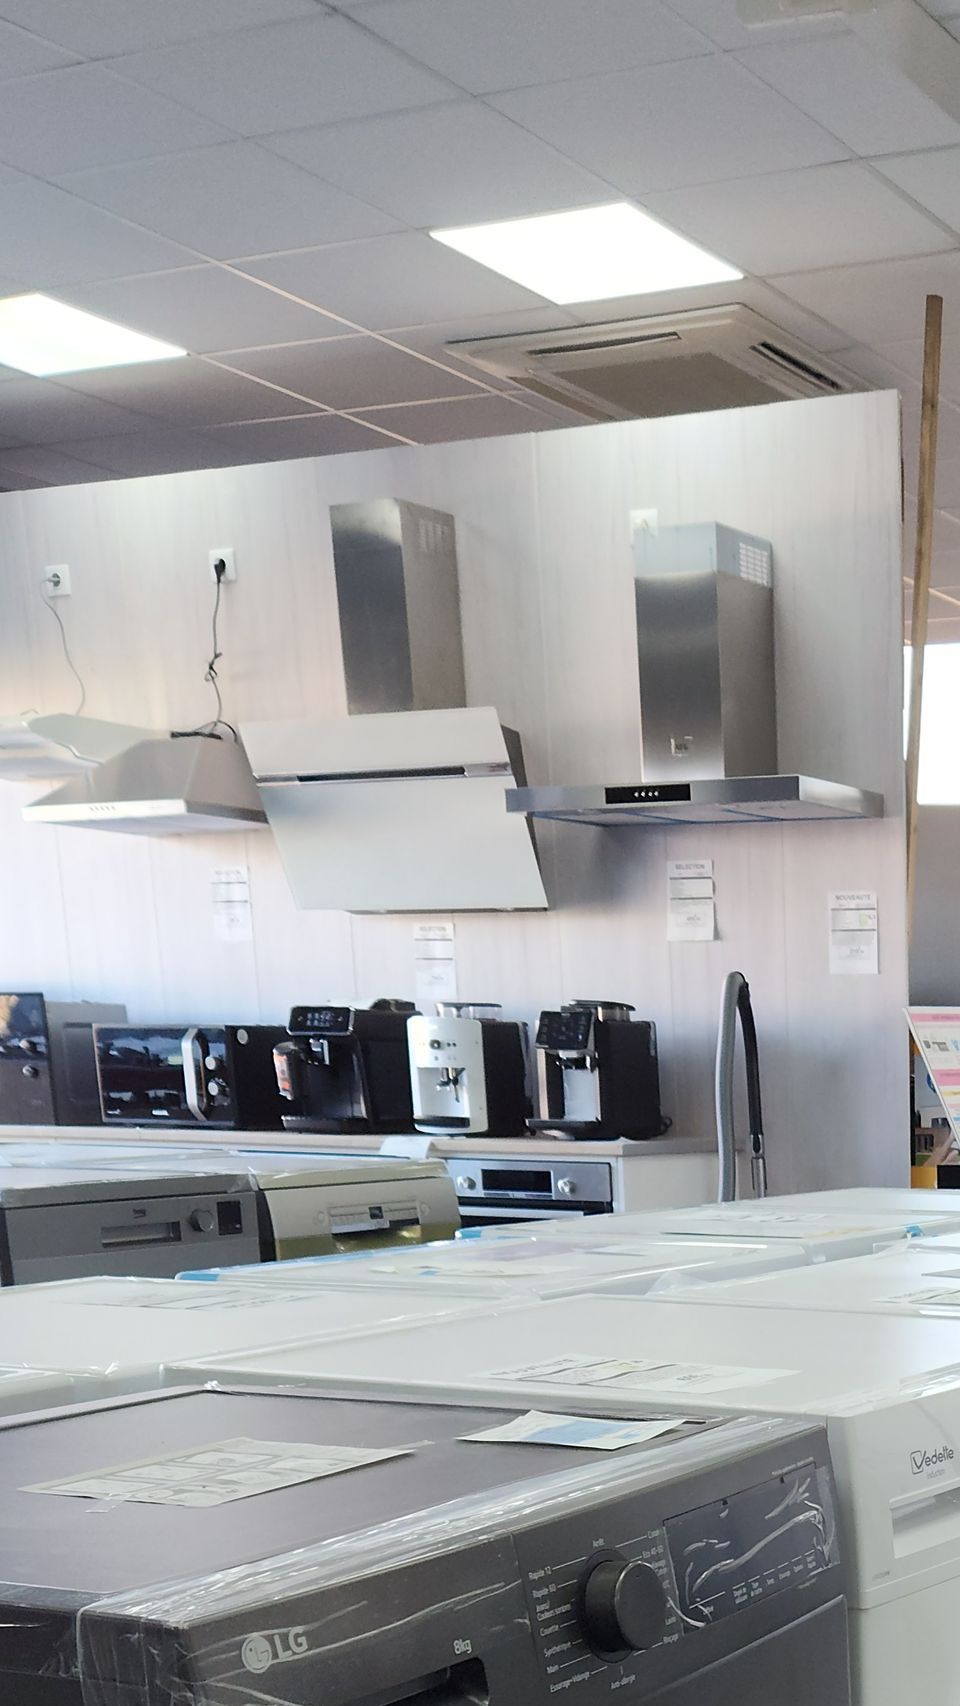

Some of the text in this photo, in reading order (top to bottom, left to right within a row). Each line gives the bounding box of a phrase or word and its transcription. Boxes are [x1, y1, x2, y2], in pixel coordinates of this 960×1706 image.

[911, 1445, 954, 1472] Vedette
[273, 1627, 472, 1659] LG 8kg
